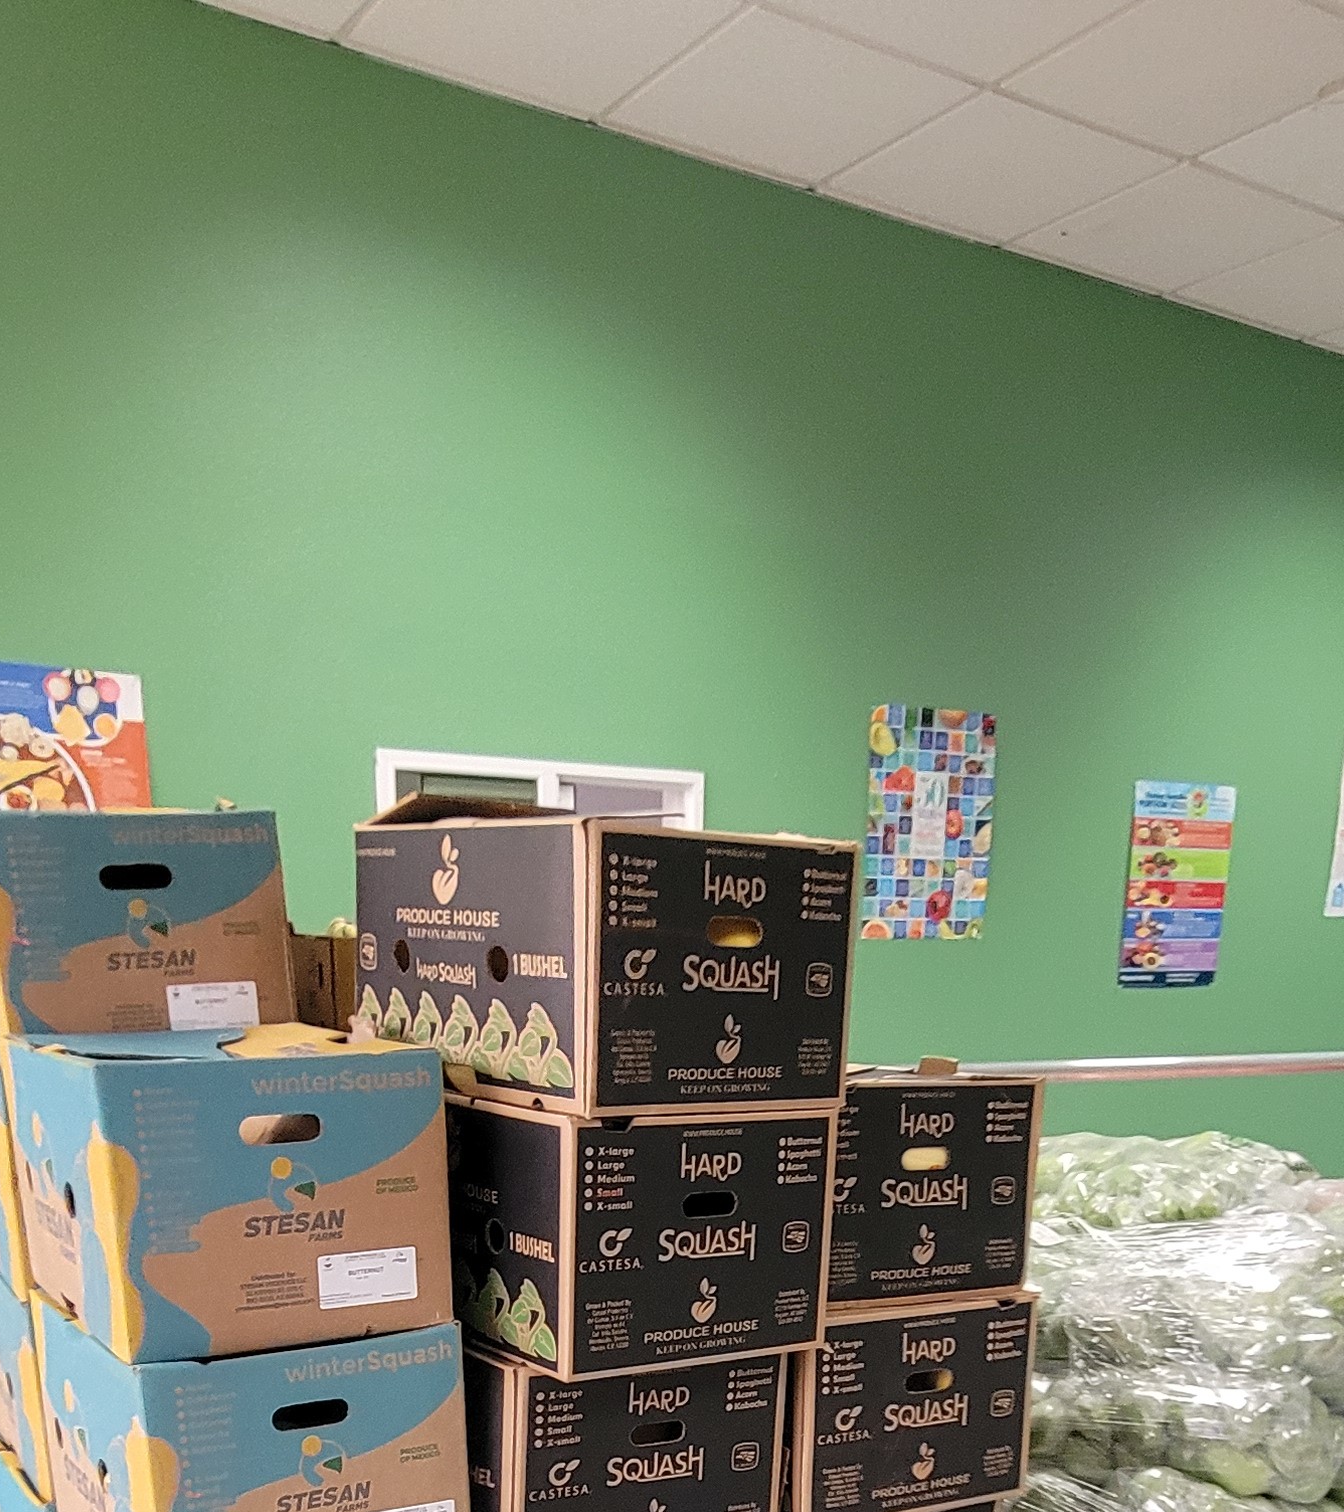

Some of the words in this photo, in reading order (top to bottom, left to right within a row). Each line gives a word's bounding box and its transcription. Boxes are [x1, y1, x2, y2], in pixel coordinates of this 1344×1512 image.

[703, 861, 767, 910] HARD
[396, 907, 450, 926] PRODUCE
[453, 910, 500, 927] HOUSE
[107, 949, 197, 971] STESAN
[512, 953, 518, 975] 1
[520, 954, 567, 979] BUSHEL
[416, 957, 439, 982] HARD
[439, 962, 477, 989] SQUASH
[683, 954, 780, 1000] SQUASH
[604, 980, 664, 997] CASTESA
[251, 1067, 431, 1095] winterSquash
[668, 1068, 734, 1081] PRODUCE
[737, 1066, 783, 1080] HOUSE
[680, 1084, 707, 1095] KEEP
[723, 1081, 771, 1094] GROWING
[899, 1103, 955, 1138] HARD
[597, 1146, 635, 1157] X-large
[597, 1160, 626, 1172] Large
[680, 1142, 742, 1183] HARD
[376, 1175, 415, 1188] PRODUCE
[597, 1173, 636, 1184] Medium
[389, 1184, 419, 1194] MEXICO
[597, 1187, 624, 1198] Small
[880, 1174, 968, 1210] SQUASH
[597, 1201, 633, 1212] X-small
[244, 1208, 345, 1238] STESAN
[308, 1230, 343, 1242] FARMS
[657, 1220, 757, 1262] SQUASH
[509, 1231, 514, 1251] 1
[515, 1232, 555, 1263] BUSHEL
[579, 1258, 641, 1274] CASTESA
[871, 1267, 929, 1281] PRODUCE
[932, 1263, 972, 1275] HOUSE
[644, 1324, 711, 1345] PRODUCE
[713, 1319, 759, 1334] HOUSE
[656, 1343, 682, 1355] KEEP
[683, 1341, 694, 1352] ON
[695, 1336, 746, 1350] GROWING
[833, 1340, 864, 1351] X-large
[902, 1332, 955, 1365] HARD
[284, 1339, 453, 1385] winterSquash
[833, 1352, 856, 1361] Large
[737, 1365, 774, 1378] Butternut
[833, 1362, 864, 1372] Medium
[736, 1376, 773, 1391] Spaghetti
[833, 1373, 855, 1384] Small
[549, 1388, 583, 1401] X-large
[628, 1382, 690, 1416] HARD
[735, 1389, 758, 1399] Acorn
[547, 1401, 574, 1414] Large
[884, 1393, 969, 1432] SQUASH
[547, 1412, 583, 1425] Medium
[547, 1424, 573, 1436] Small
[817, 1430, 870, 1446] CASTESA
[399, 1443, 439, 1456] PRODUCE
[545, 1435, 581, 1448] X-small
[399, 1454, 410, 1463] OF
[411, 1449, 441, 1461] MEXICO
[606, 1444, 704, 1487] SQUASH
[529, 1484, 590, 1502] CASTESA
[872, 1482, 929, 1500] PRODUCE
[930, 1472, 972, 1490] HOUSE
